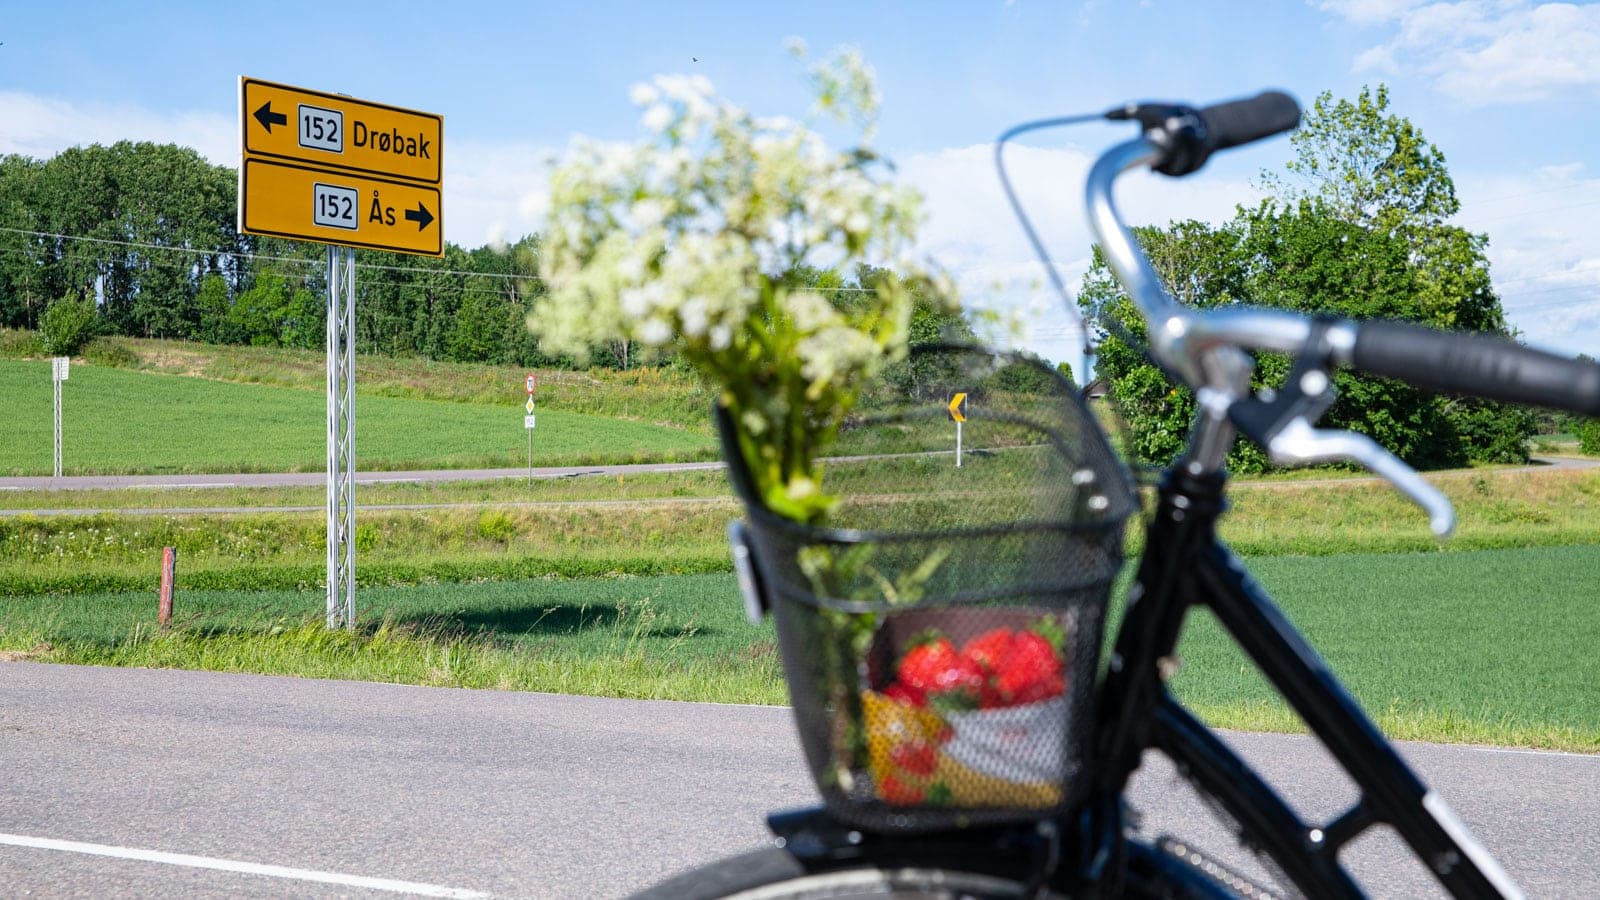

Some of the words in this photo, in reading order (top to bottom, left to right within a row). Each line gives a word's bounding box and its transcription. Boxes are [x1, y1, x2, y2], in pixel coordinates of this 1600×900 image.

[304, 115, 338, 143] 152
[353, 120, 431, 159] Drøbak
[319, 193, 353, 220] 152
[368, 190, 396, 226] Ås
